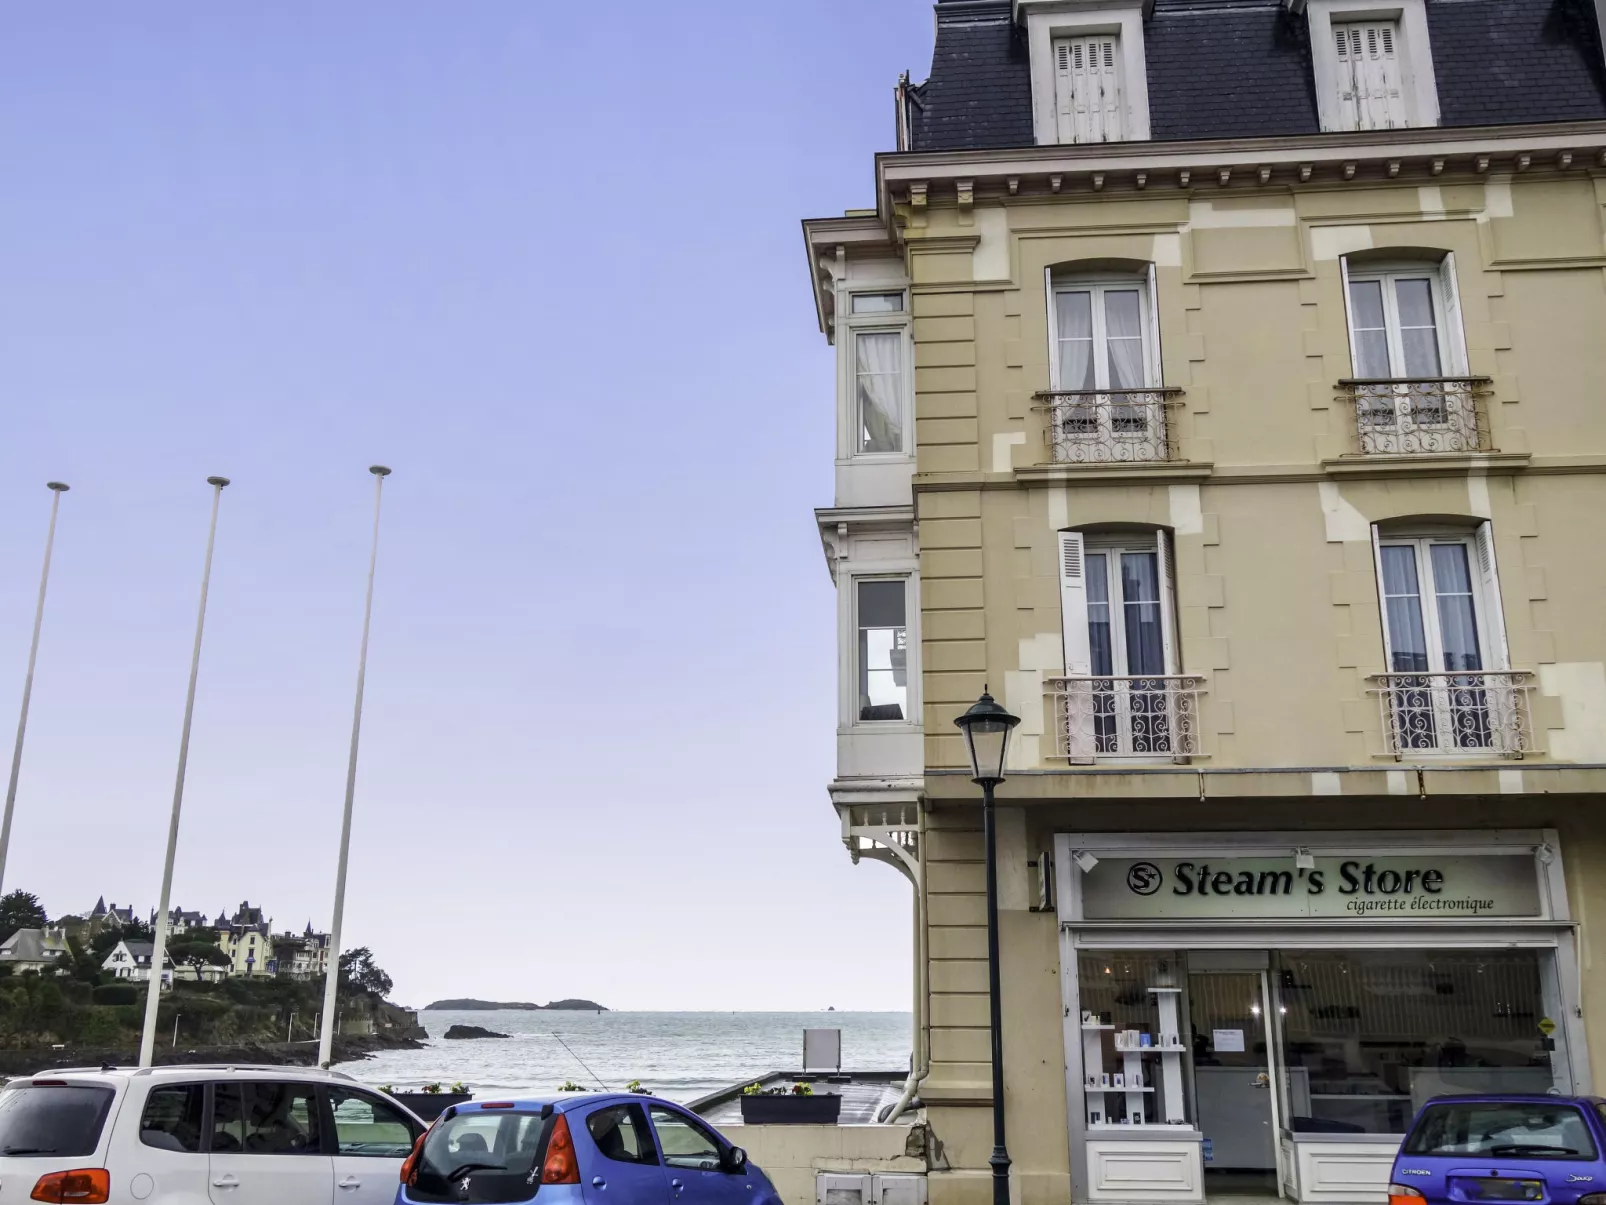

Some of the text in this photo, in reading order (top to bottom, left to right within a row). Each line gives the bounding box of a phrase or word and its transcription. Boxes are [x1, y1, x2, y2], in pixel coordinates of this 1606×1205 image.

[1172, 862, 1325, 896] Steam's
[1338, 861, 1445, 895] Store
[1346, 895, 1494, 915] cigarette électronique
